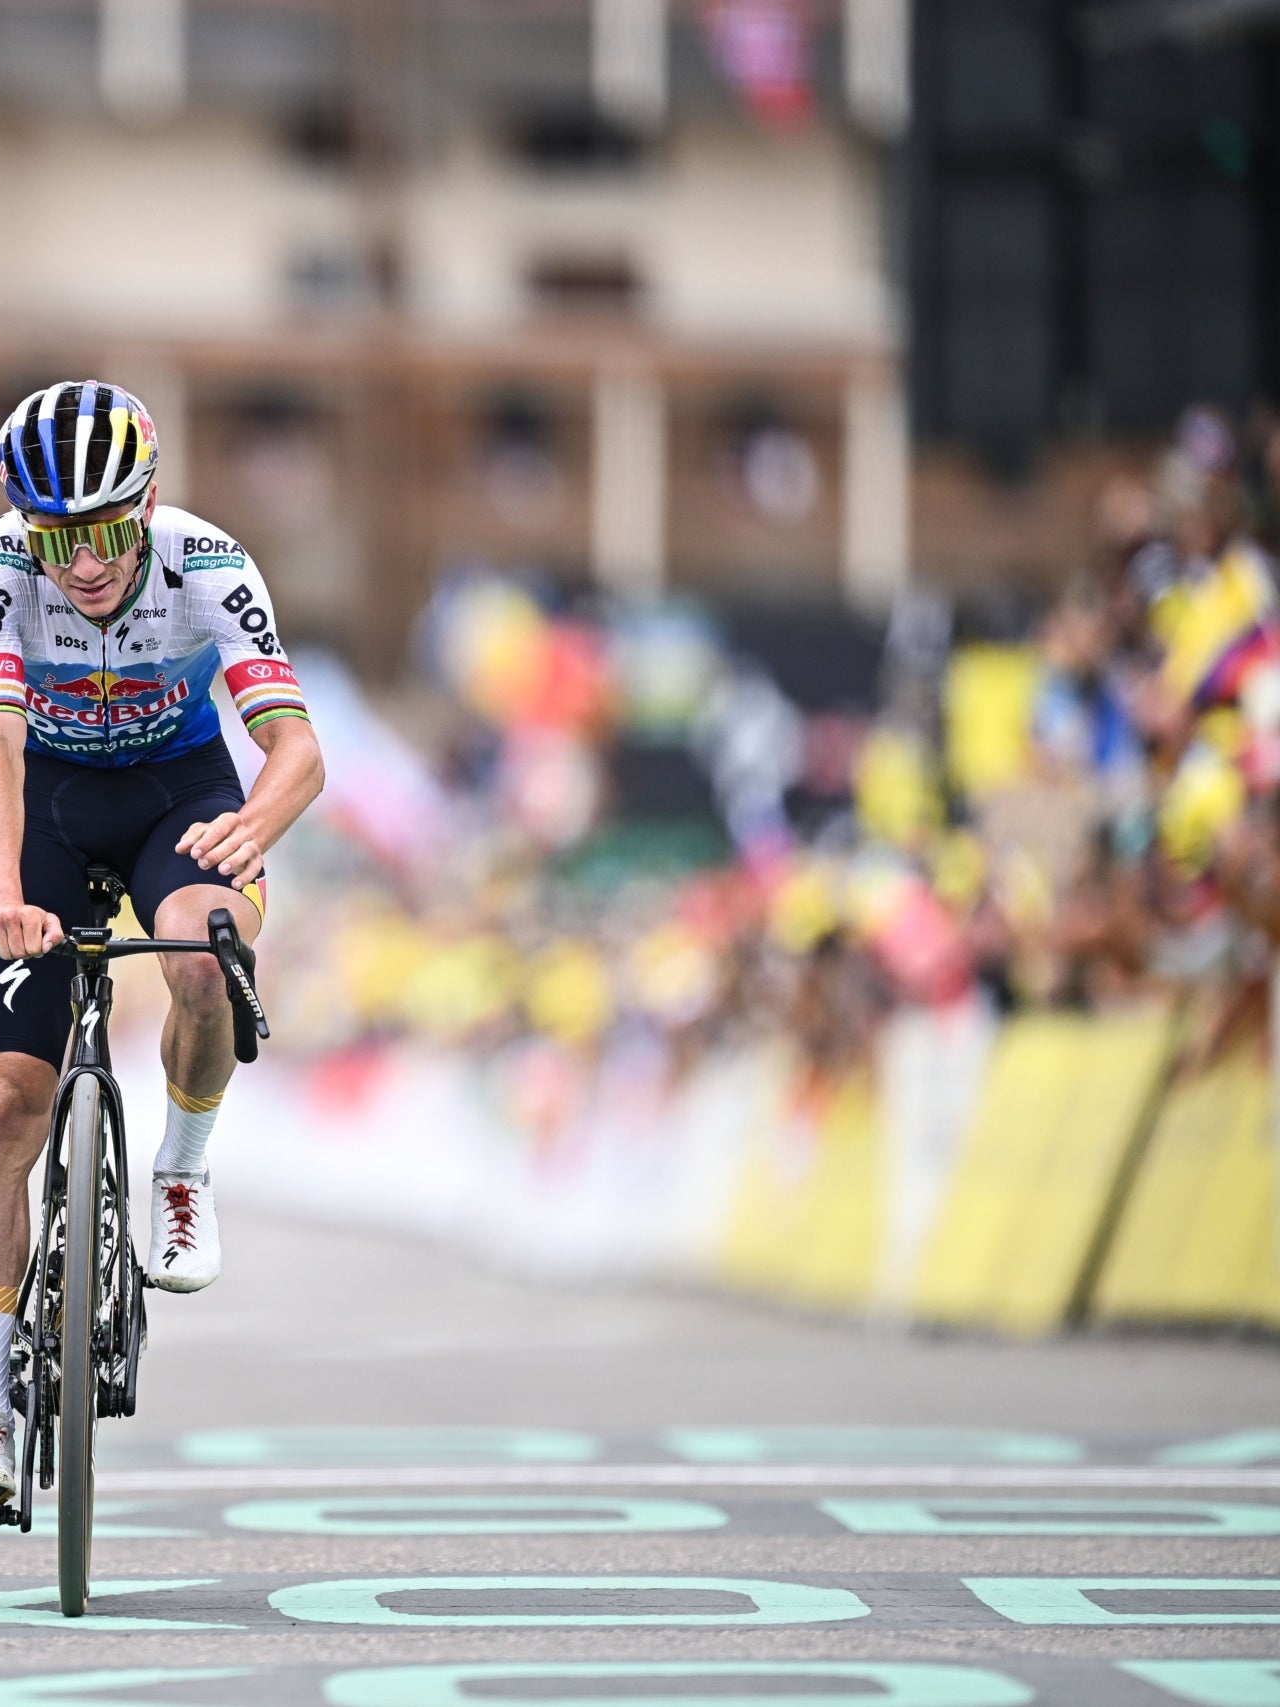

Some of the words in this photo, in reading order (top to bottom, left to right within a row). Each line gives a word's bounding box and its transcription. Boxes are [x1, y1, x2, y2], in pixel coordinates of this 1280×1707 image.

[183, 537, 245, 556] BORA
[184, 554, 243, 569] hansgrohe
[132, 608, 167, 620] grenke
[221, 583, 281, 656] BOS
[55, 635, 88, 651] BOSS
